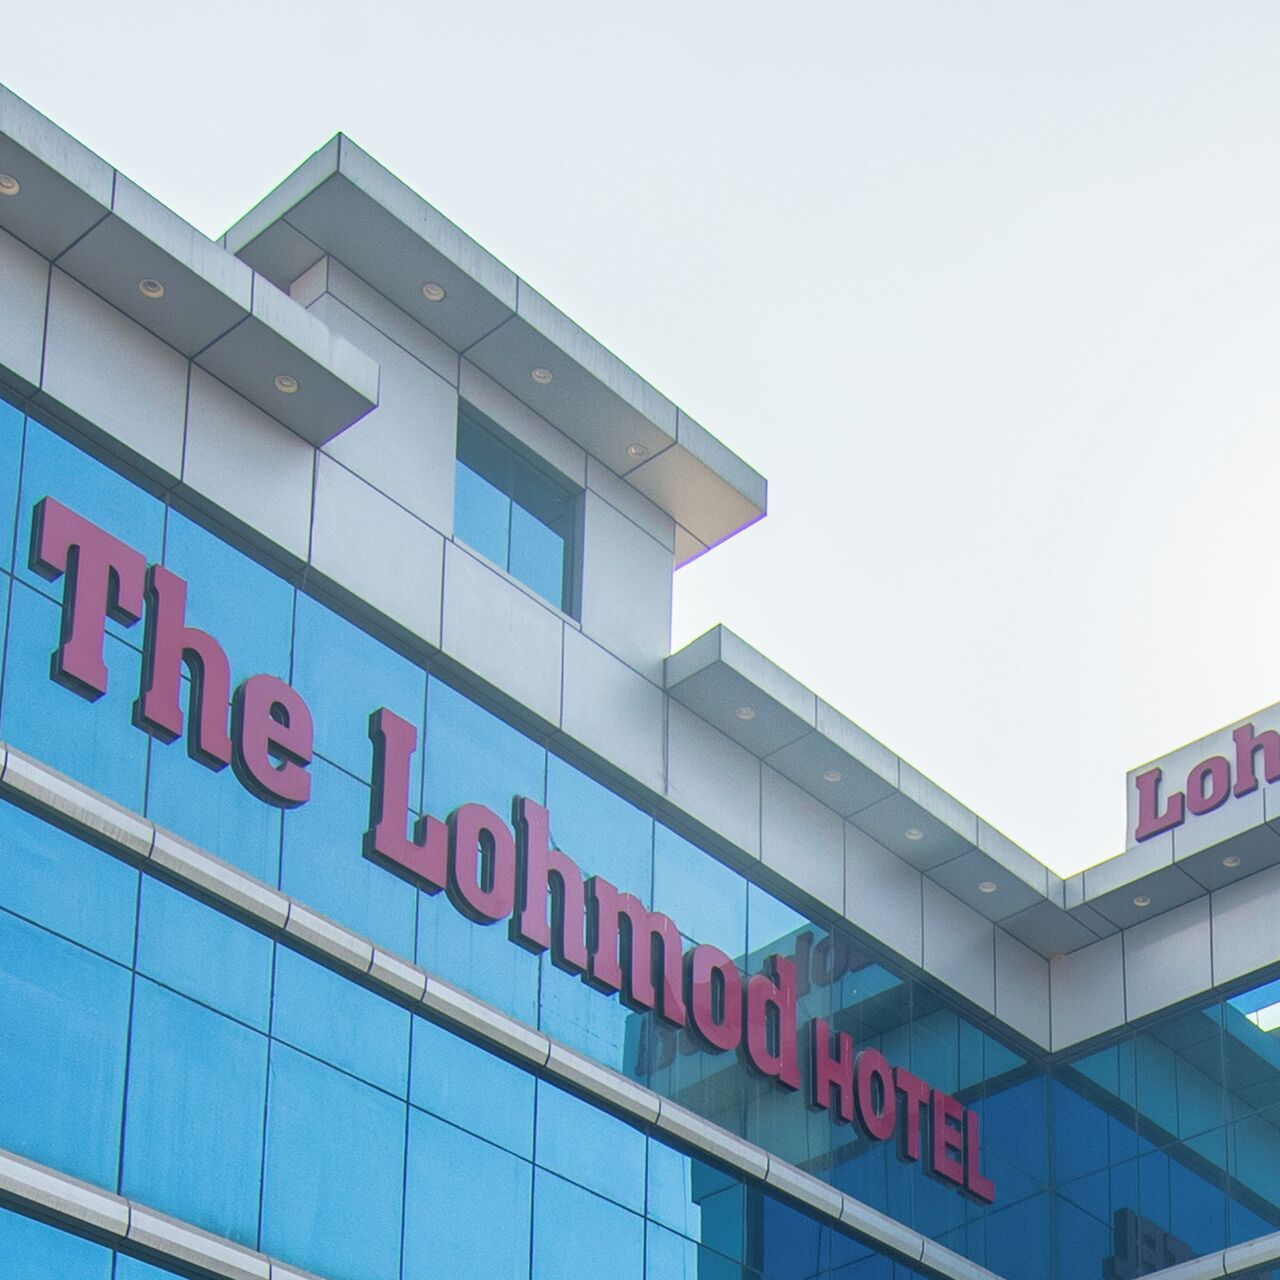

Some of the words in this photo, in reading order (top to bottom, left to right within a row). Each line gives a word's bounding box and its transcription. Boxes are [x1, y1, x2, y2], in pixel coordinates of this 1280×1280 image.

[28, 495, 314, 809] The
[362, 706, 802, 1093] Lohmod
[810, 1017, 996, 1205] HOTEL
